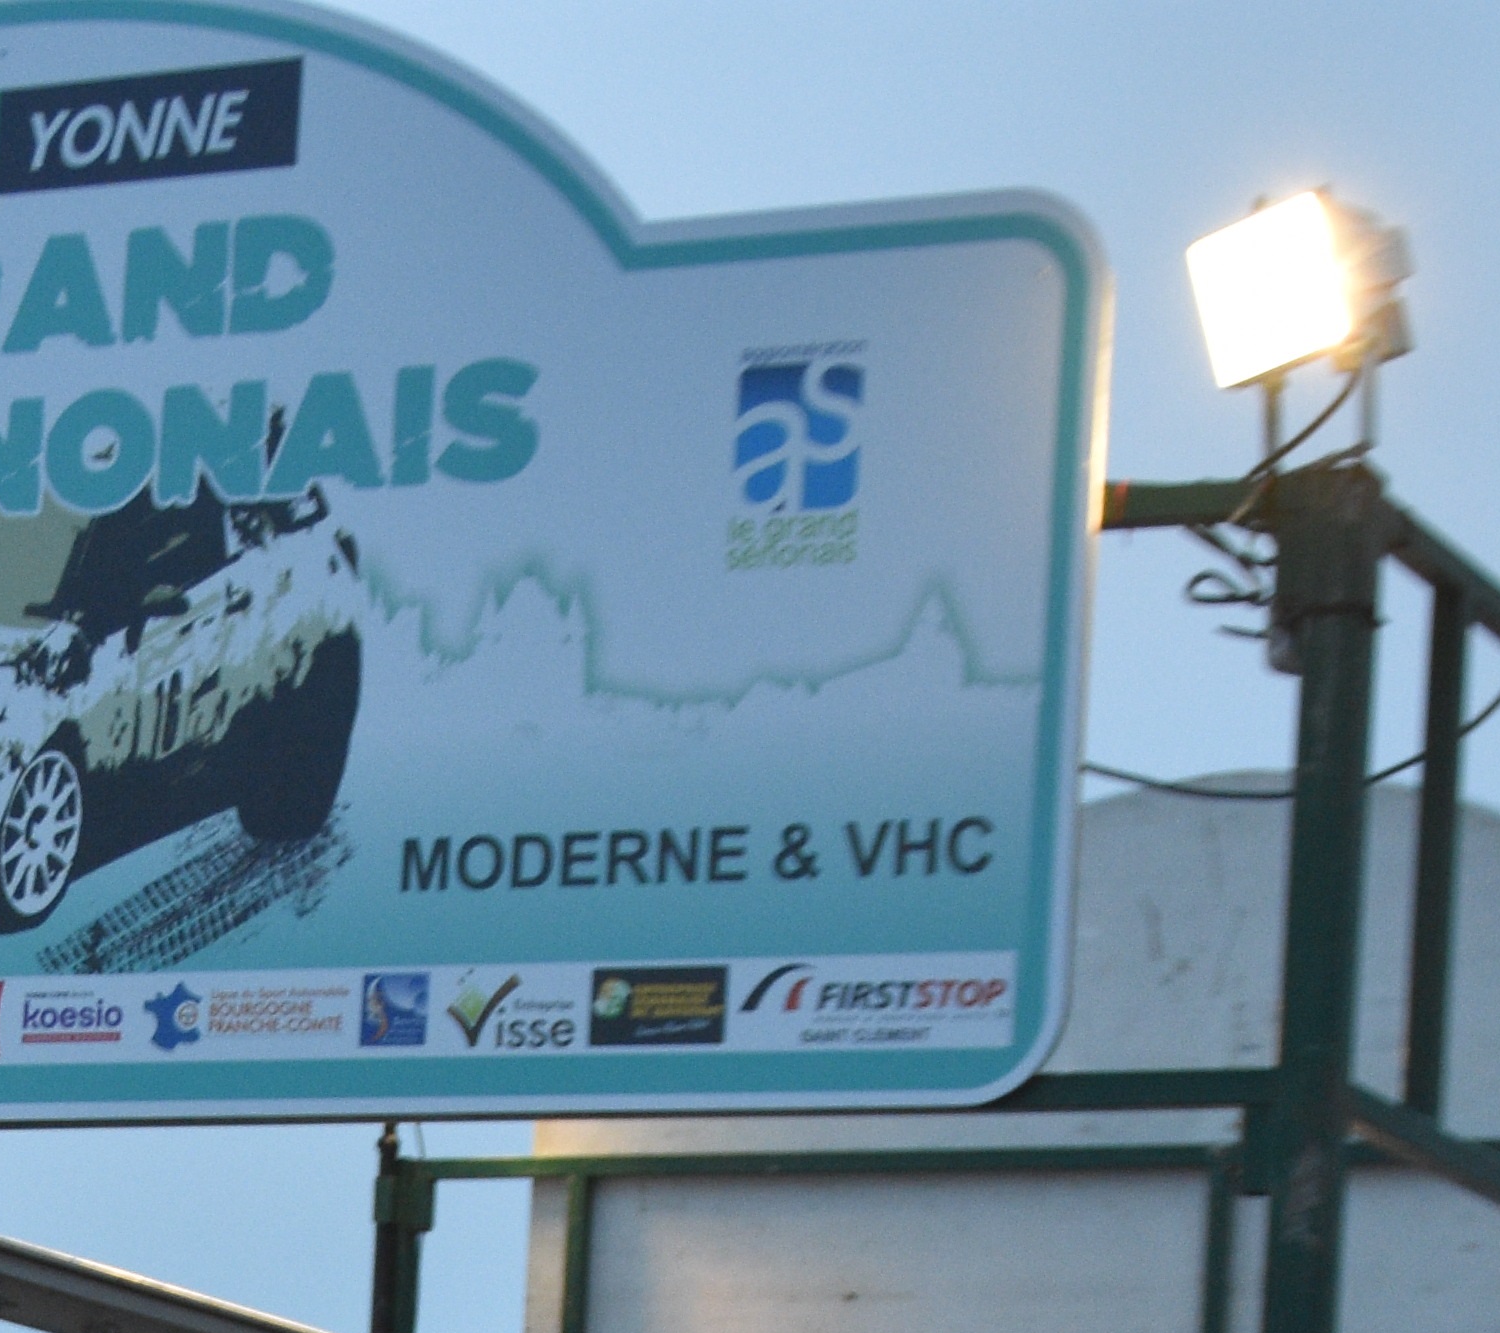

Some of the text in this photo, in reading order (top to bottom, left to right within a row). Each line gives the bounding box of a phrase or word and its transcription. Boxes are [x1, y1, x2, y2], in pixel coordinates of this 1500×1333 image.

[27, 88, 250, 171] YONNE
[763, 508, 860, 549] grand
[400, 815, 995, 891] MODERNE & VHC
[22, 998, 124, 1032] koesio
